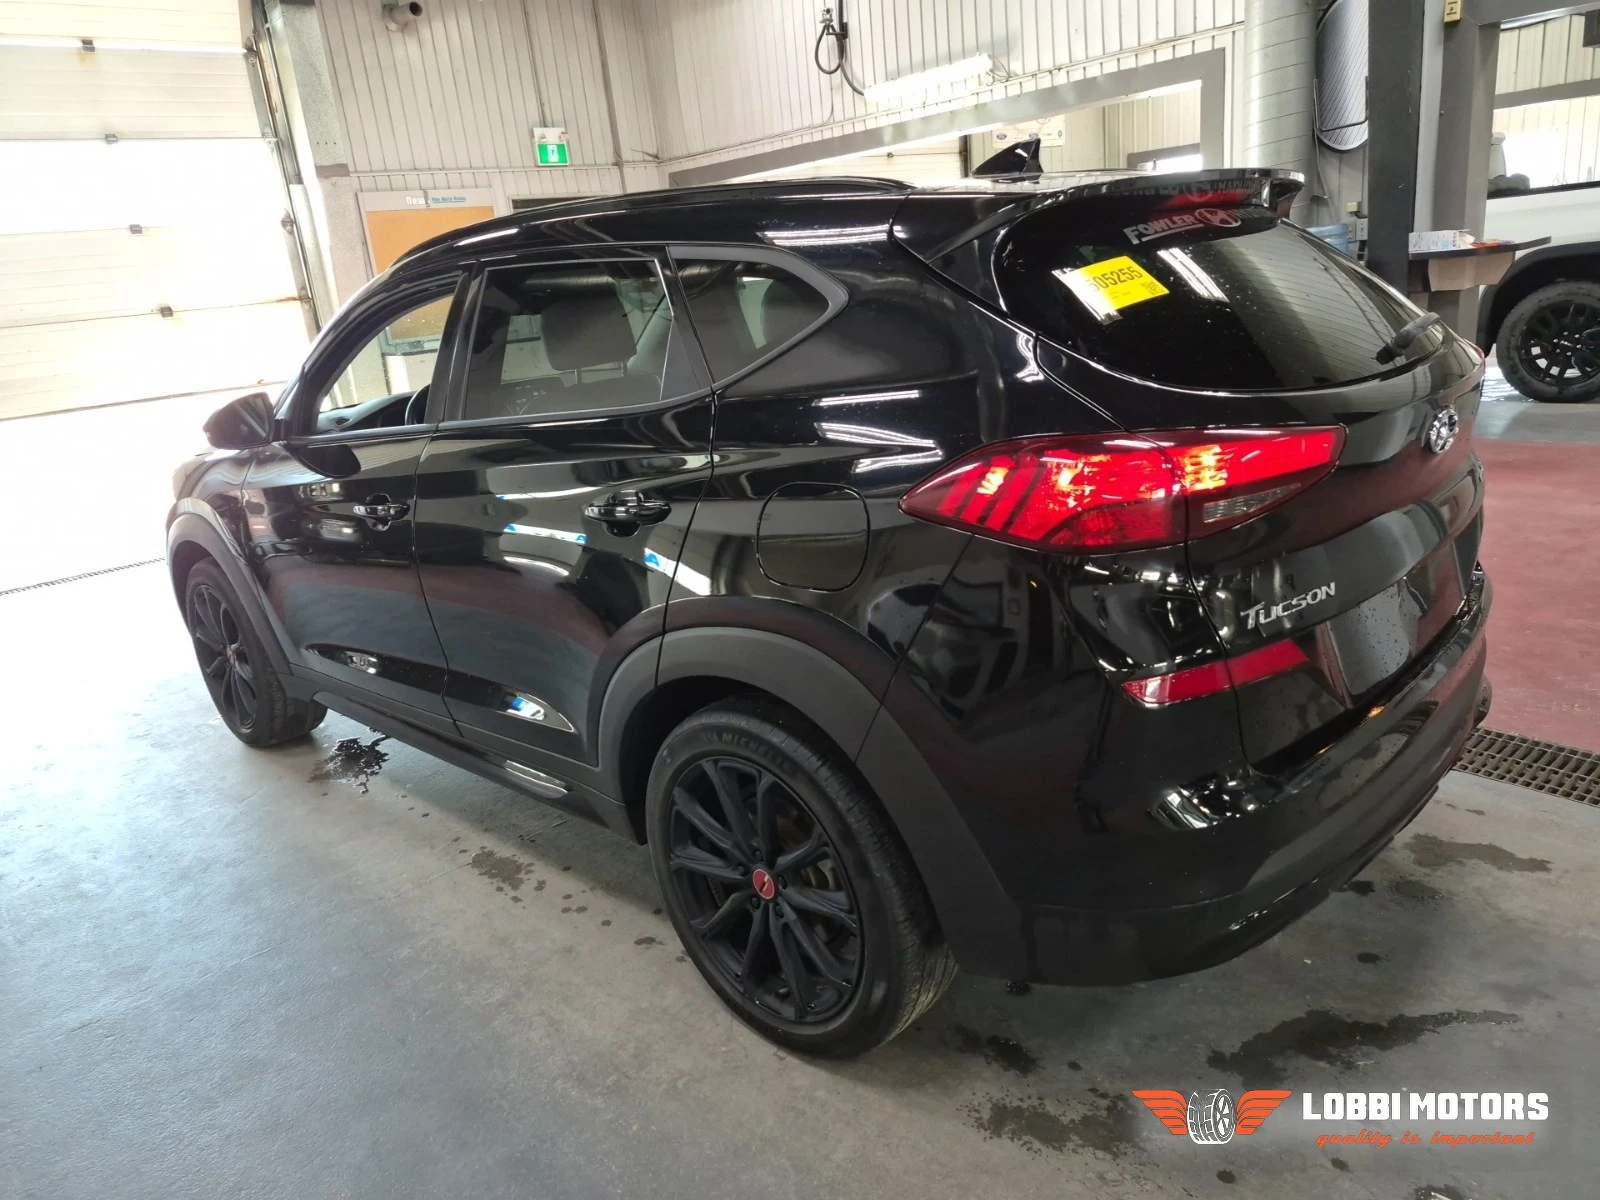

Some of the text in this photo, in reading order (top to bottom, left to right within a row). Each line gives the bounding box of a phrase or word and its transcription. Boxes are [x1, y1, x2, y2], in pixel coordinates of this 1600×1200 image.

[405, 195, 430, 206] New
[1122, 213, 1197, 245] FOWLER
[1240, 581, 1336, 630] TUCSON
